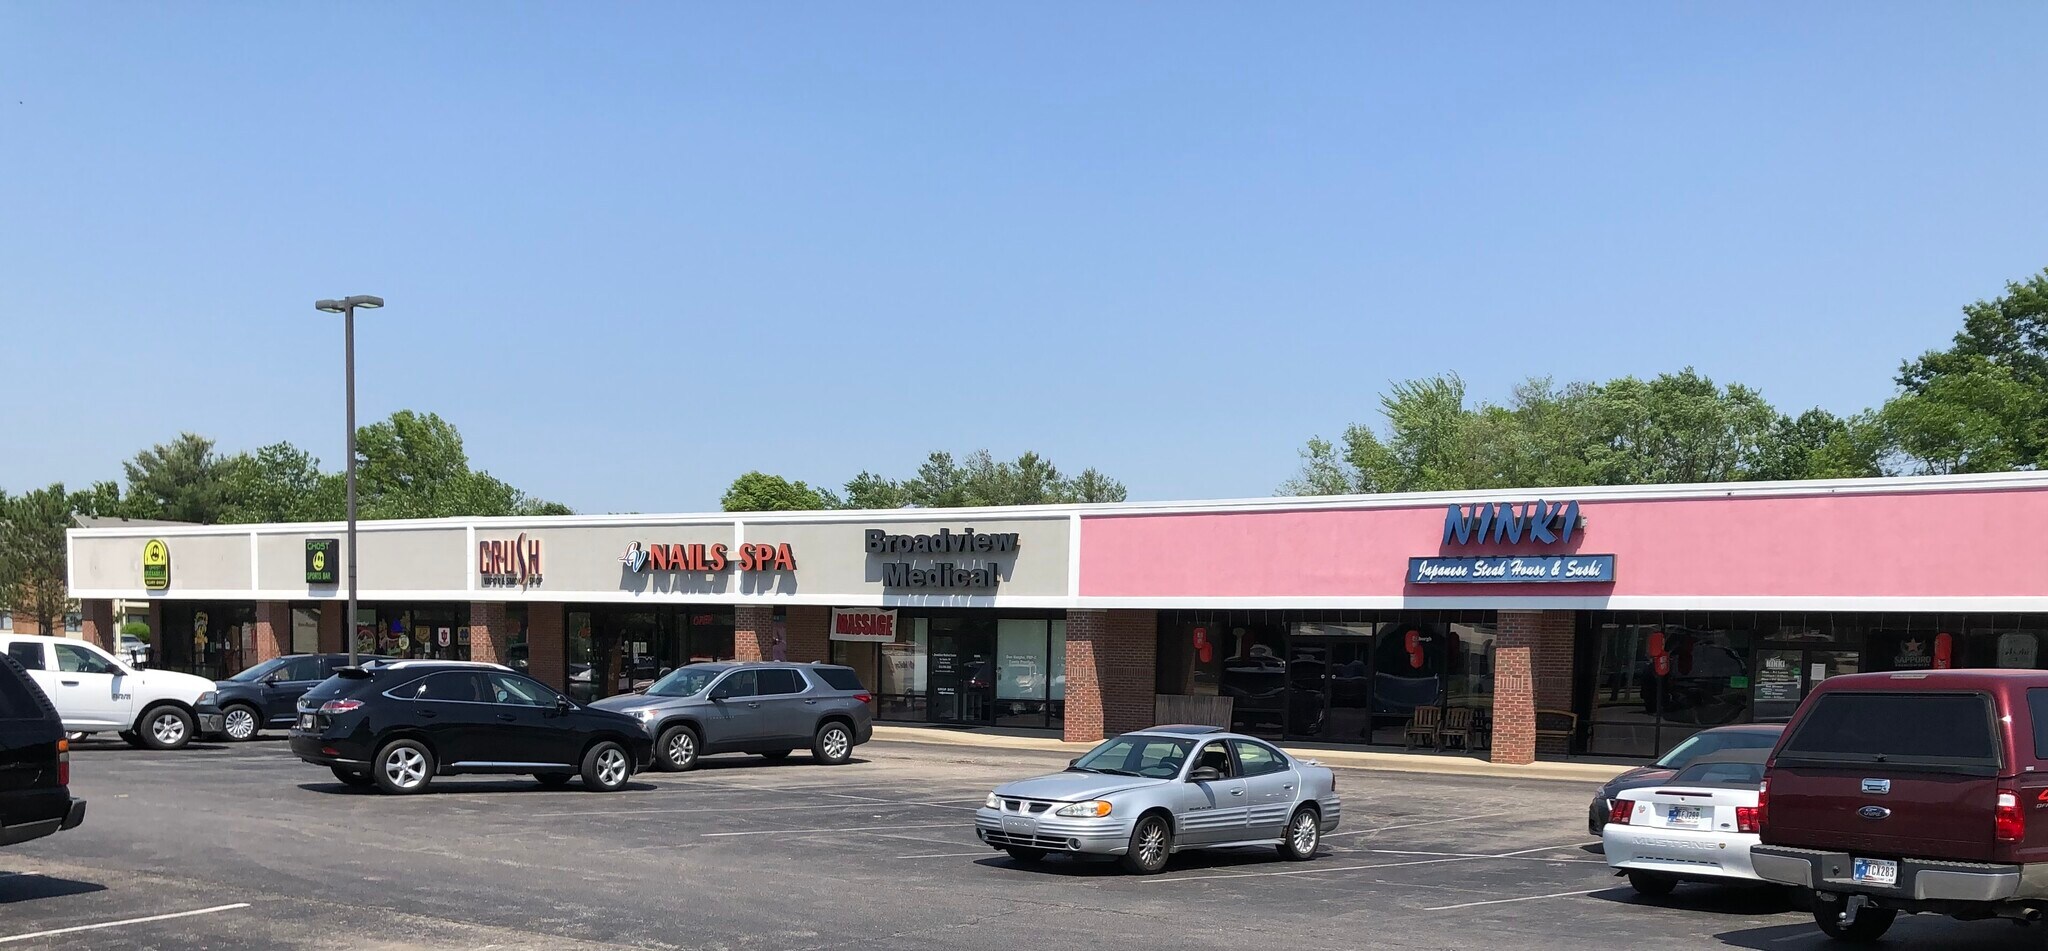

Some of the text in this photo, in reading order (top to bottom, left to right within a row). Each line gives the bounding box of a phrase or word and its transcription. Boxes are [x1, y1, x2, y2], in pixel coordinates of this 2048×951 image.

[1443, 499, 1580, 545] NINKI
[865, 528, 1019, 553] Broadview
[480, 532, 541, 585] CRUSH
[650, 543, 728, 571] NAILS
[738, 543, 798, 571] SPA
[1417, 558, 1602, 580] Japanese Steak House & Sushi
[883, 563, 1000, 587] Medical
[836, 613, 894, 636] MASSAGE
[1894, 656, 1932, 664] SAPPORO
[1632, 836, 1716, 851] MUSTANG
